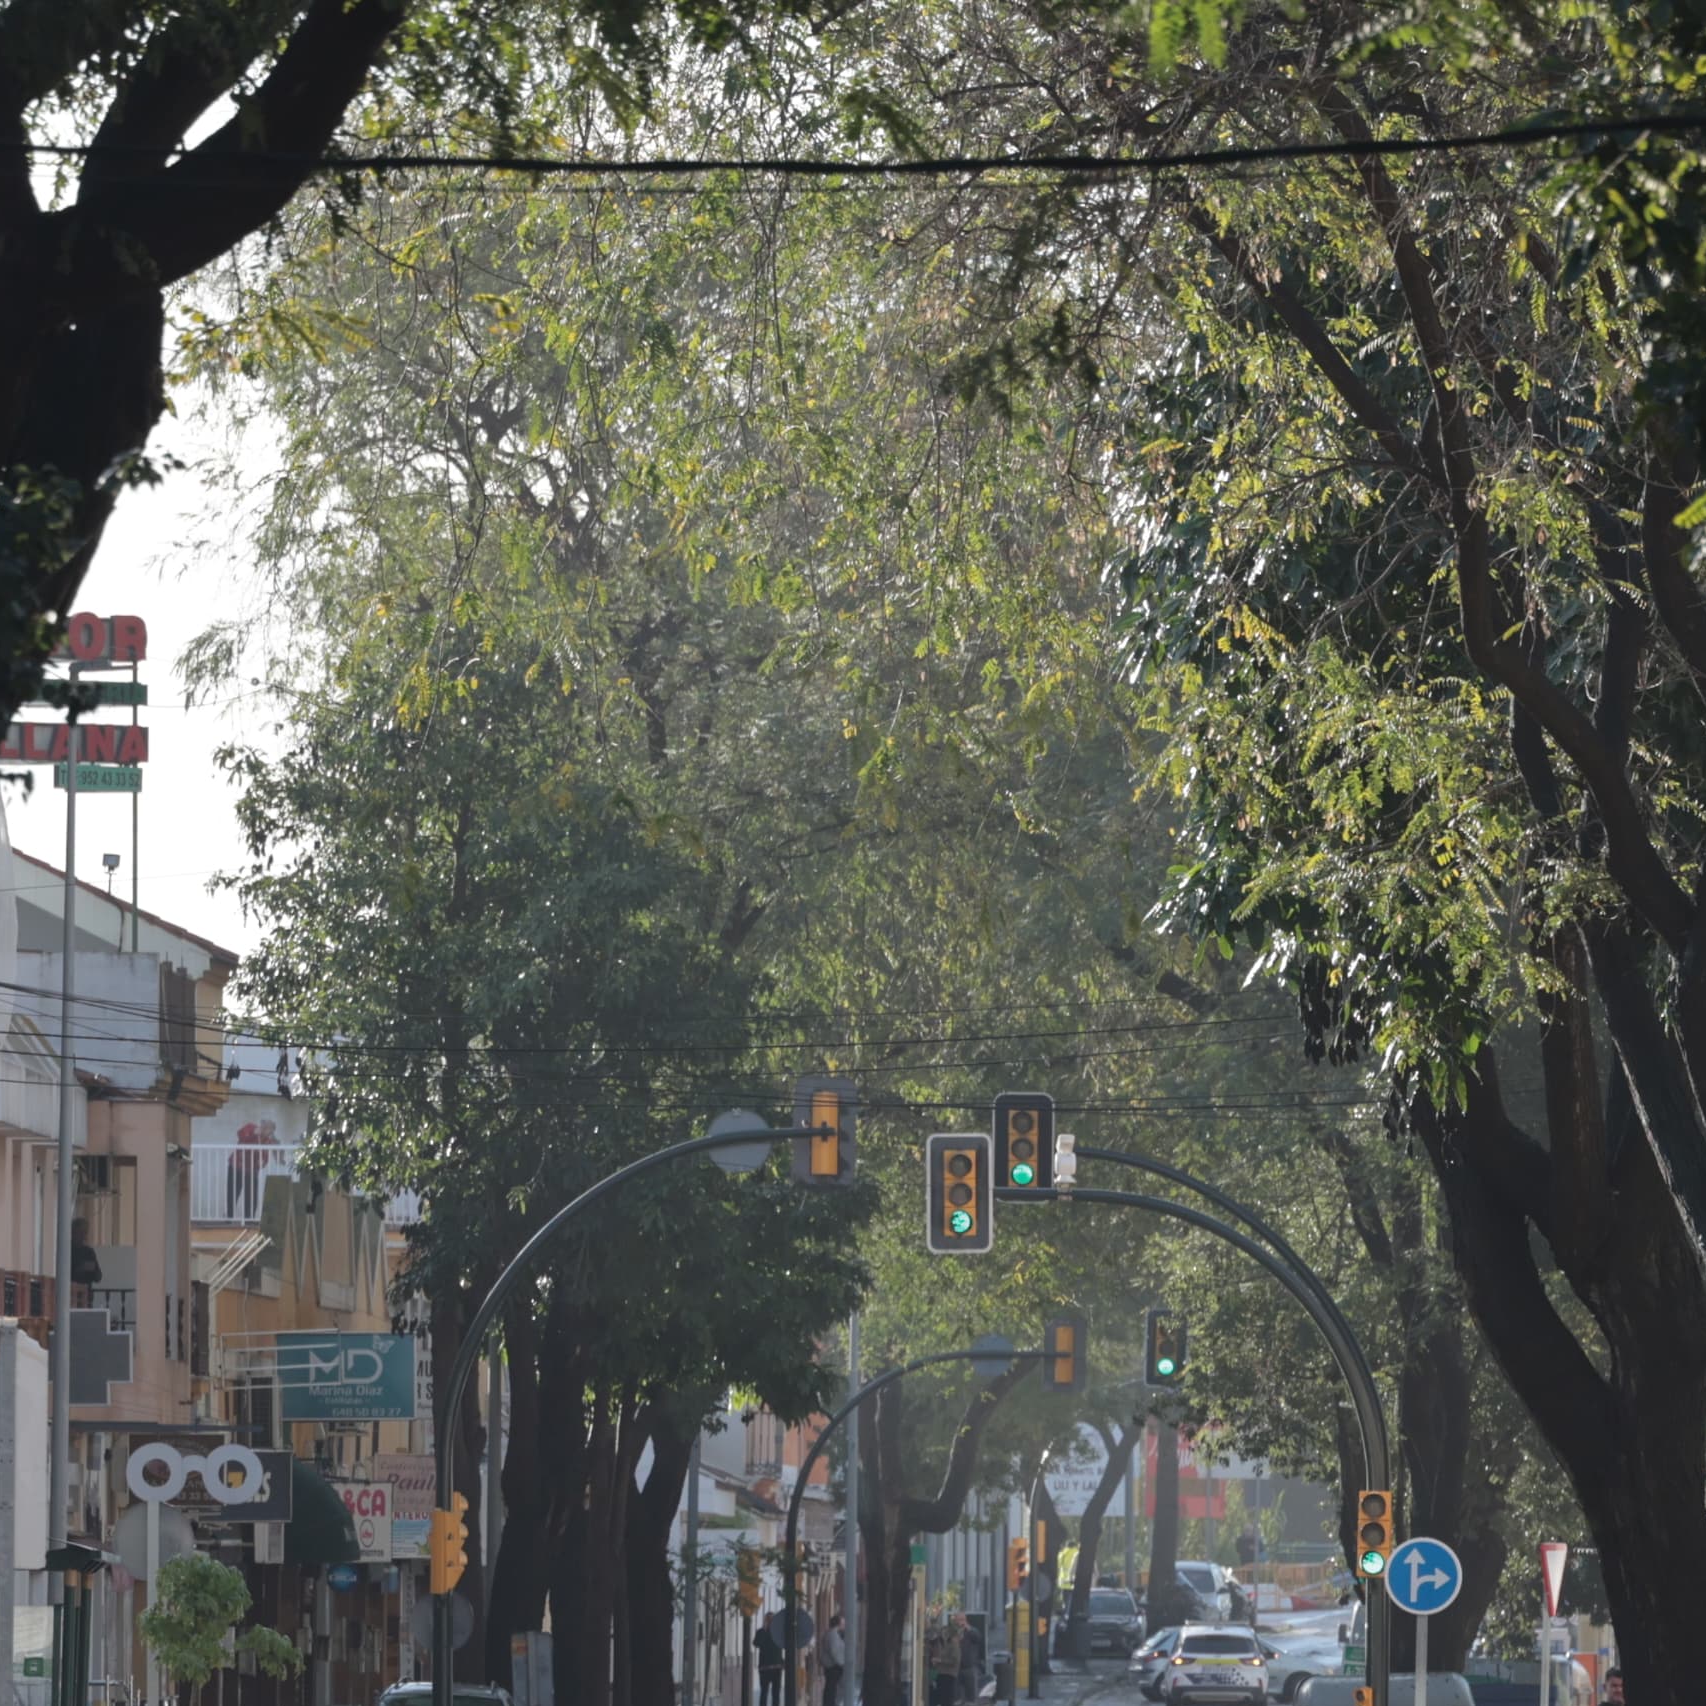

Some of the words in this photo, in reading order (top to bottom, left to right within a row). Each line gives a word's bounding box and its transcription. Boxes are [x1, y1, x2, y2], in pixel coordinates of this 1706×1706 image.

[50, 612, 147, 661] OR
[309, 1385, 352, 1397] Marina
[387, 1473, 435, 1491] Paul
